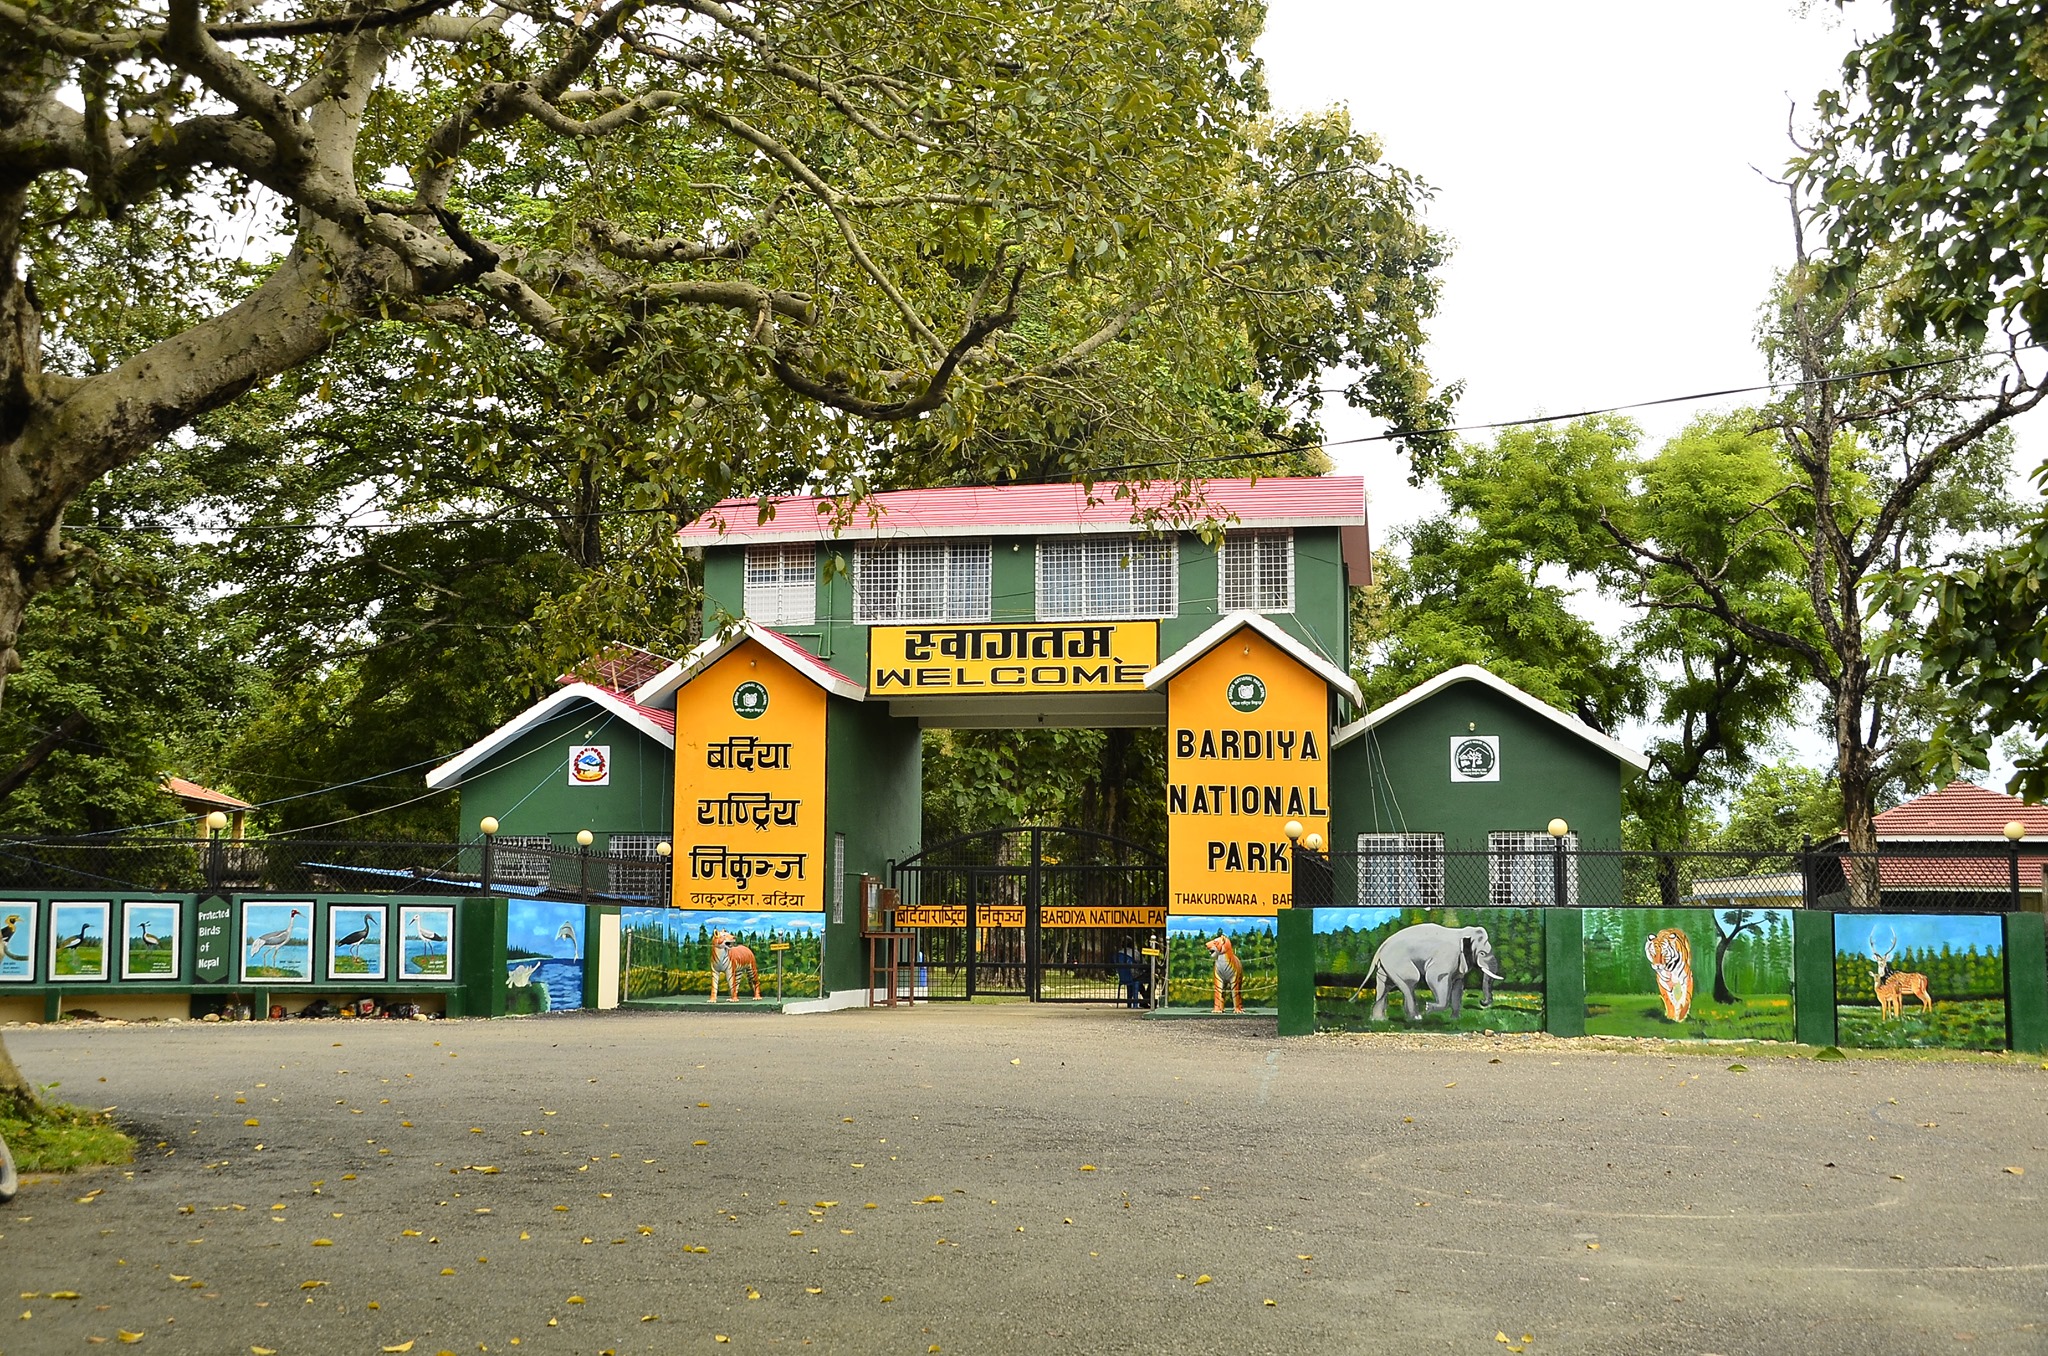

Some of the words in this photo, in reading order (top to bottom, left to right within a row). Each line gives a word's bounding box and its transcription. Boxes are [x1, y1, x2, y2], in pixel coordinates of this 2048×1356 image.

[876, 664, 1151, 688] WELCOME
[706, 736, 793, 771] बर्दिया
[1176, 729, 1320, 760] BARDIYA
[1168, 784, 1329, 816] NATIONAL
[1207, 840, 1290, 873] PARK
[198, 908, 230, 921] Protected
[1041, 910, 1086, 924] BARDIYA
[1089, 910, 1145, 924] NATIONAL
[199, 926, 221, 937] Birds
[200, 942, 210, 953] of
[198, 956, 220, 970] Nepal
